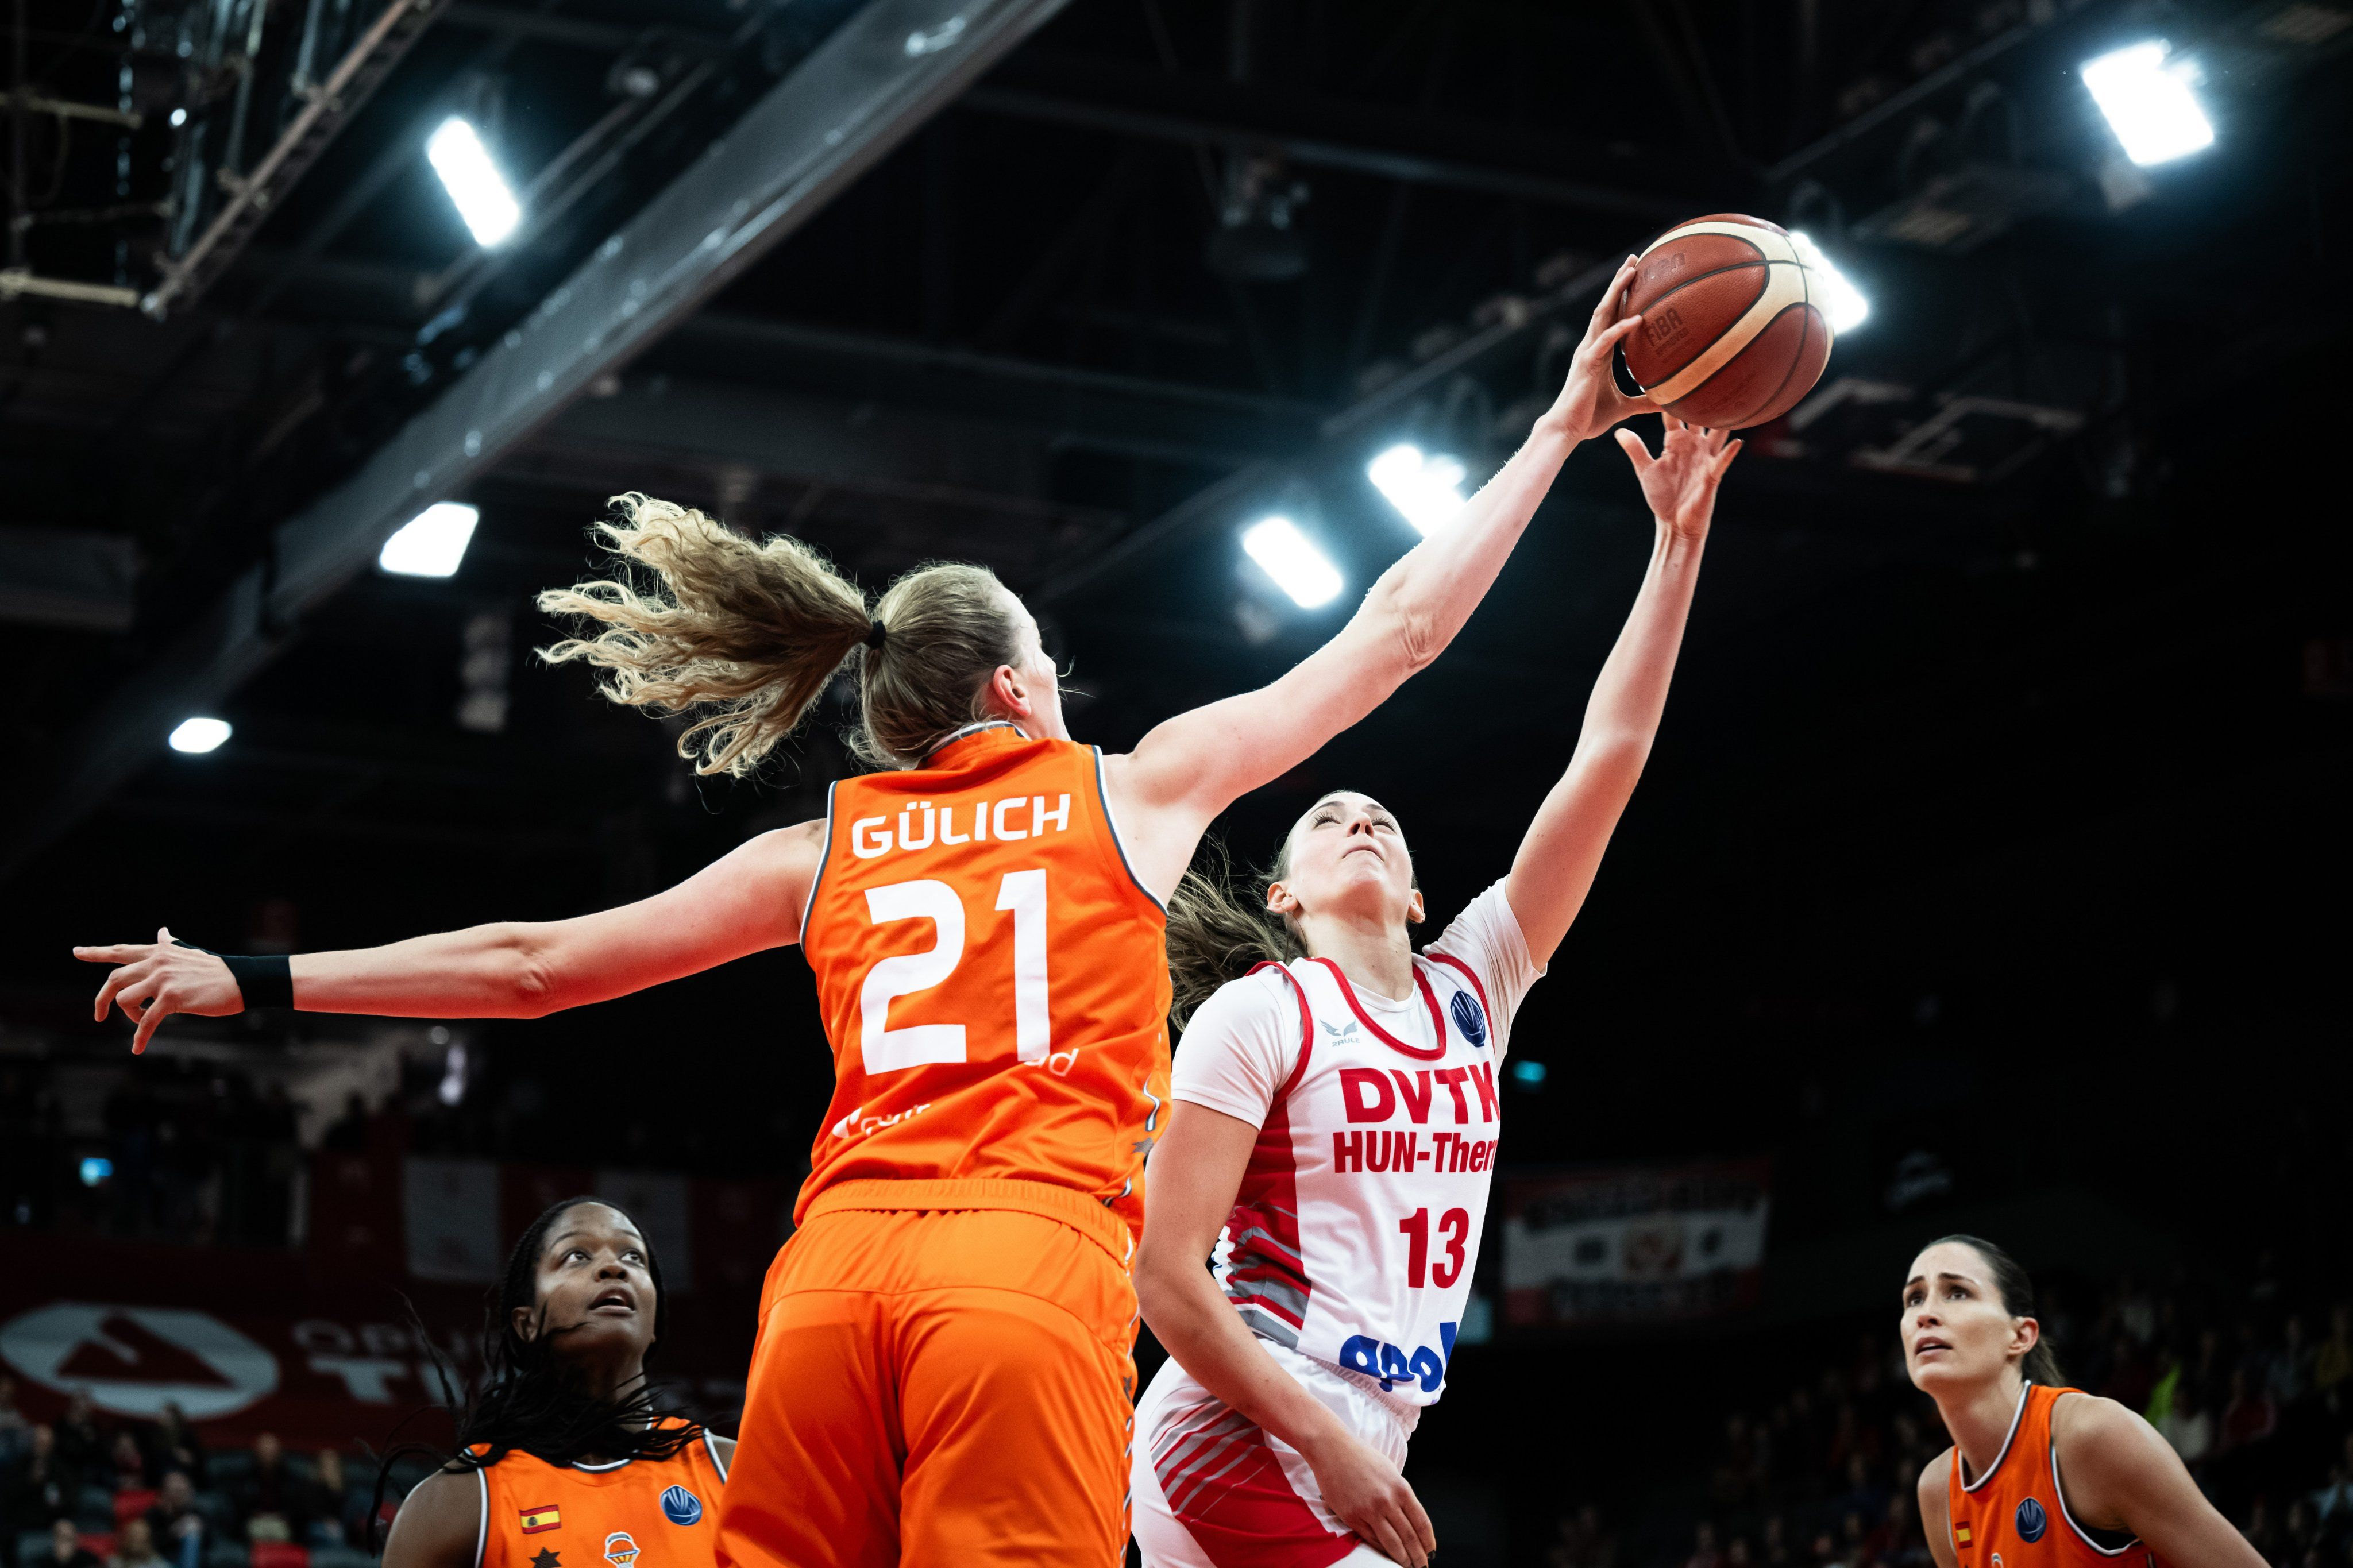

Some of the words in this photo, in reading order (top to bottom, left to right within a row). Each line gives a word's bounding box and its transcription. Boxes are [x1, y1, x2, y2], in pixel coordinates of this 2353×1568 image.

[1644, 308, 1683, 347] FIBA
[851, 793, 1071, 859] GÜLICH
[861, 868, 1051, 1076] 21
[1339, 1061, 1500, 1125] DVTK
[1399, 1207, 1470, 1289] 13
